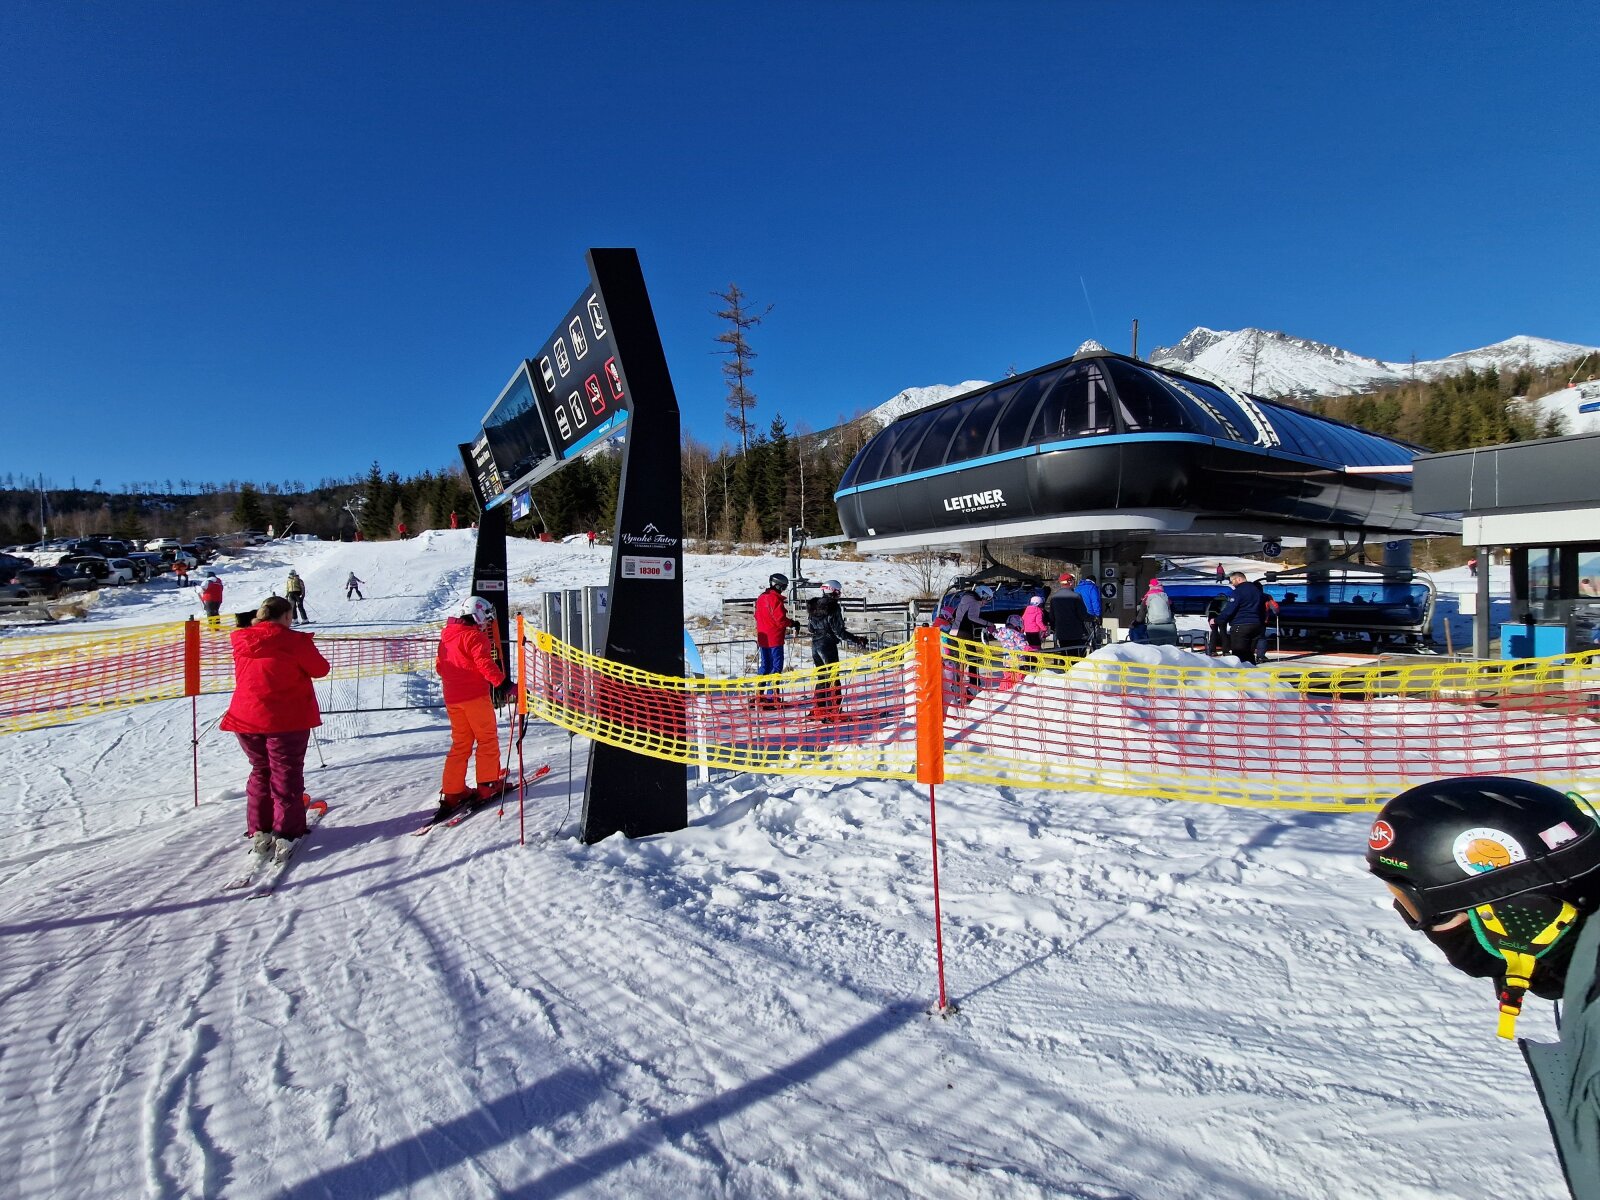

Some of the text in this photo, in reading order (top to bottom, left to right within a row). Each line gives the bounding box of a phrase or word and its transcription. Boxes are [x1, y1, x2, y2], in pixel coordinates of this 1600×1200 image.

[943, 489, 1005, 511] LEITNER
[961, 502, 1008, 513] ropeways
[621, 533, 678, 546] Vysoké Tatry
[639, 567, 661, 575] 18300
